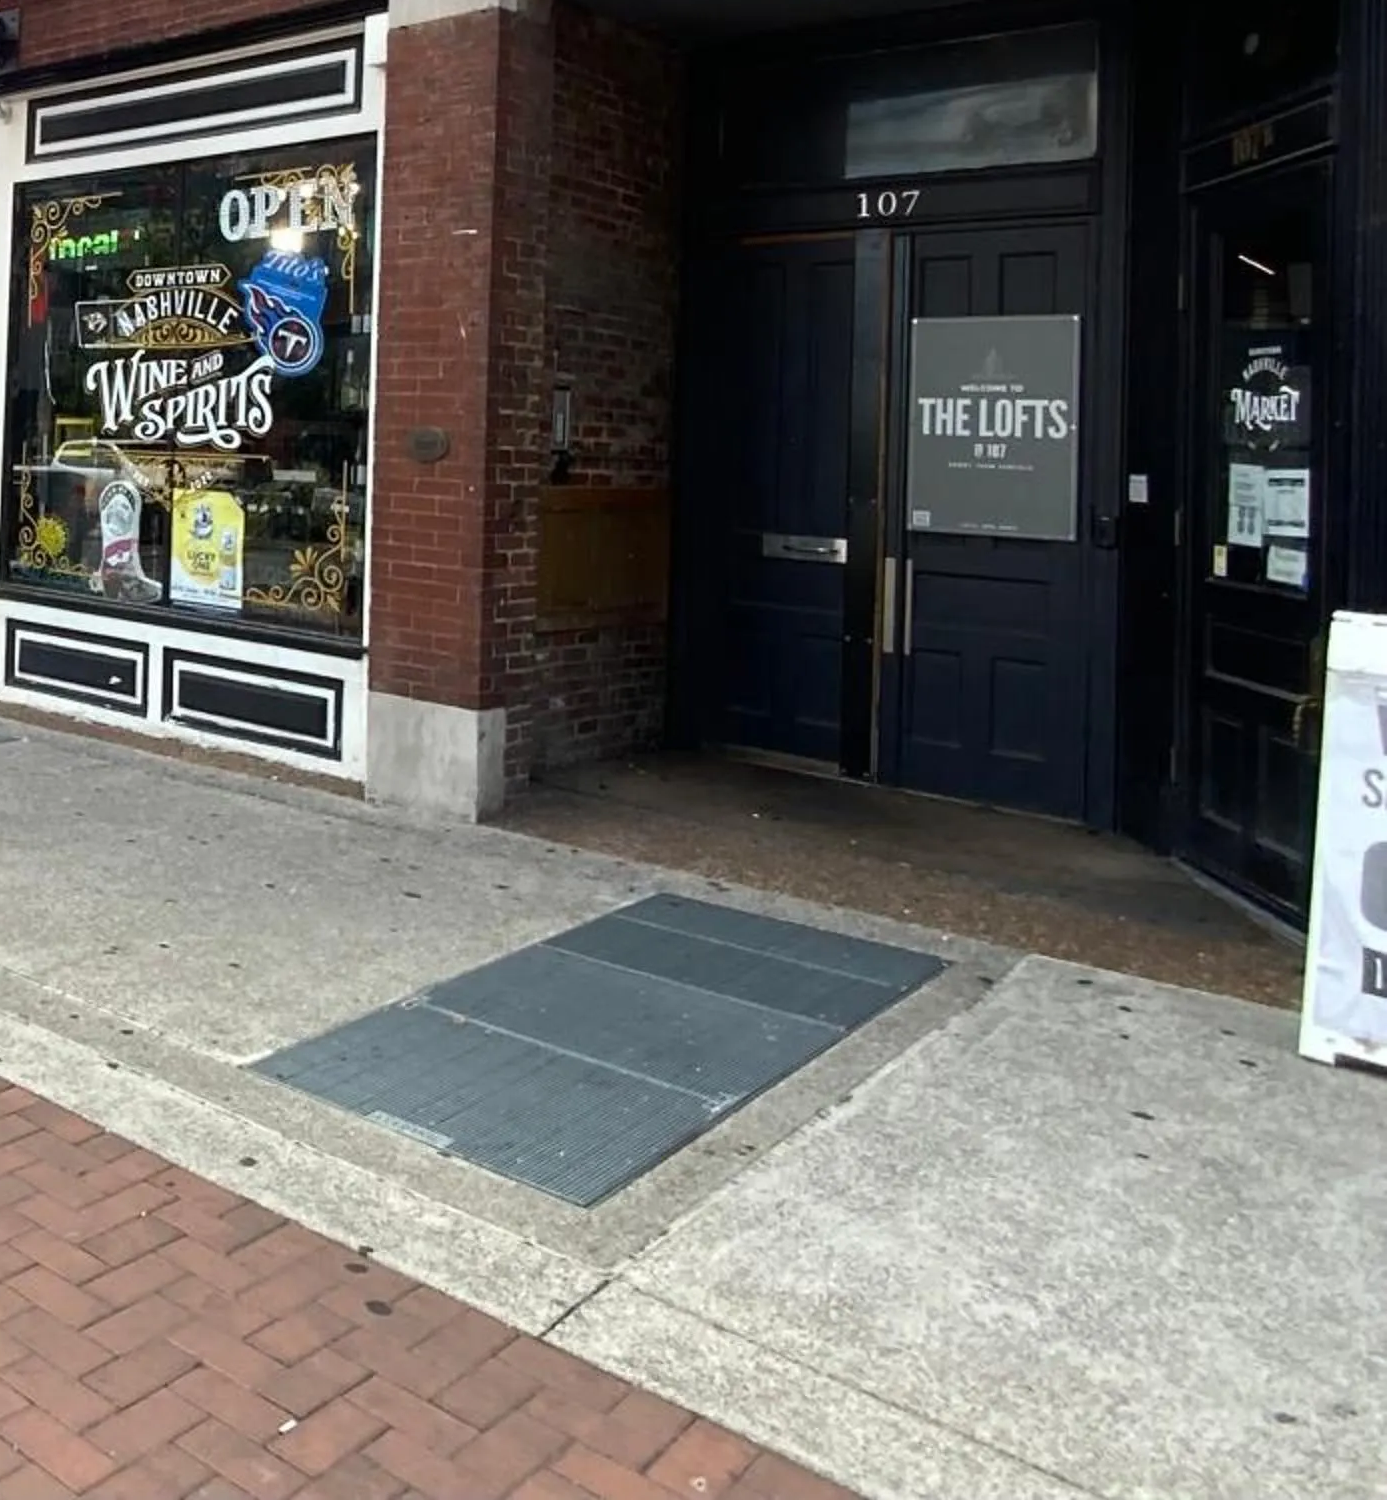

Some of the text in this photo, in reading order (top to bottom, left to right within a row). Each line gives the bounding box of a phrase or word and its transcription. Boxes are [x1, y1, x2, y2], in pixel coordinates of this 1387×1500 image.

[219, 175, 357, 242] OPEN
[855, 190, 921, 218] 107
[134, 268, 221, 288] DOWNTOWN
[115, 289, 239, 338] NASHVILLE
[85, 349, 224, 432] WINE AND
[134, 353, 278, 450] SPIRITS
[1230, 385, 1300, 431] MARKET
[918, 396, 1069, 439] THE LOFTS
